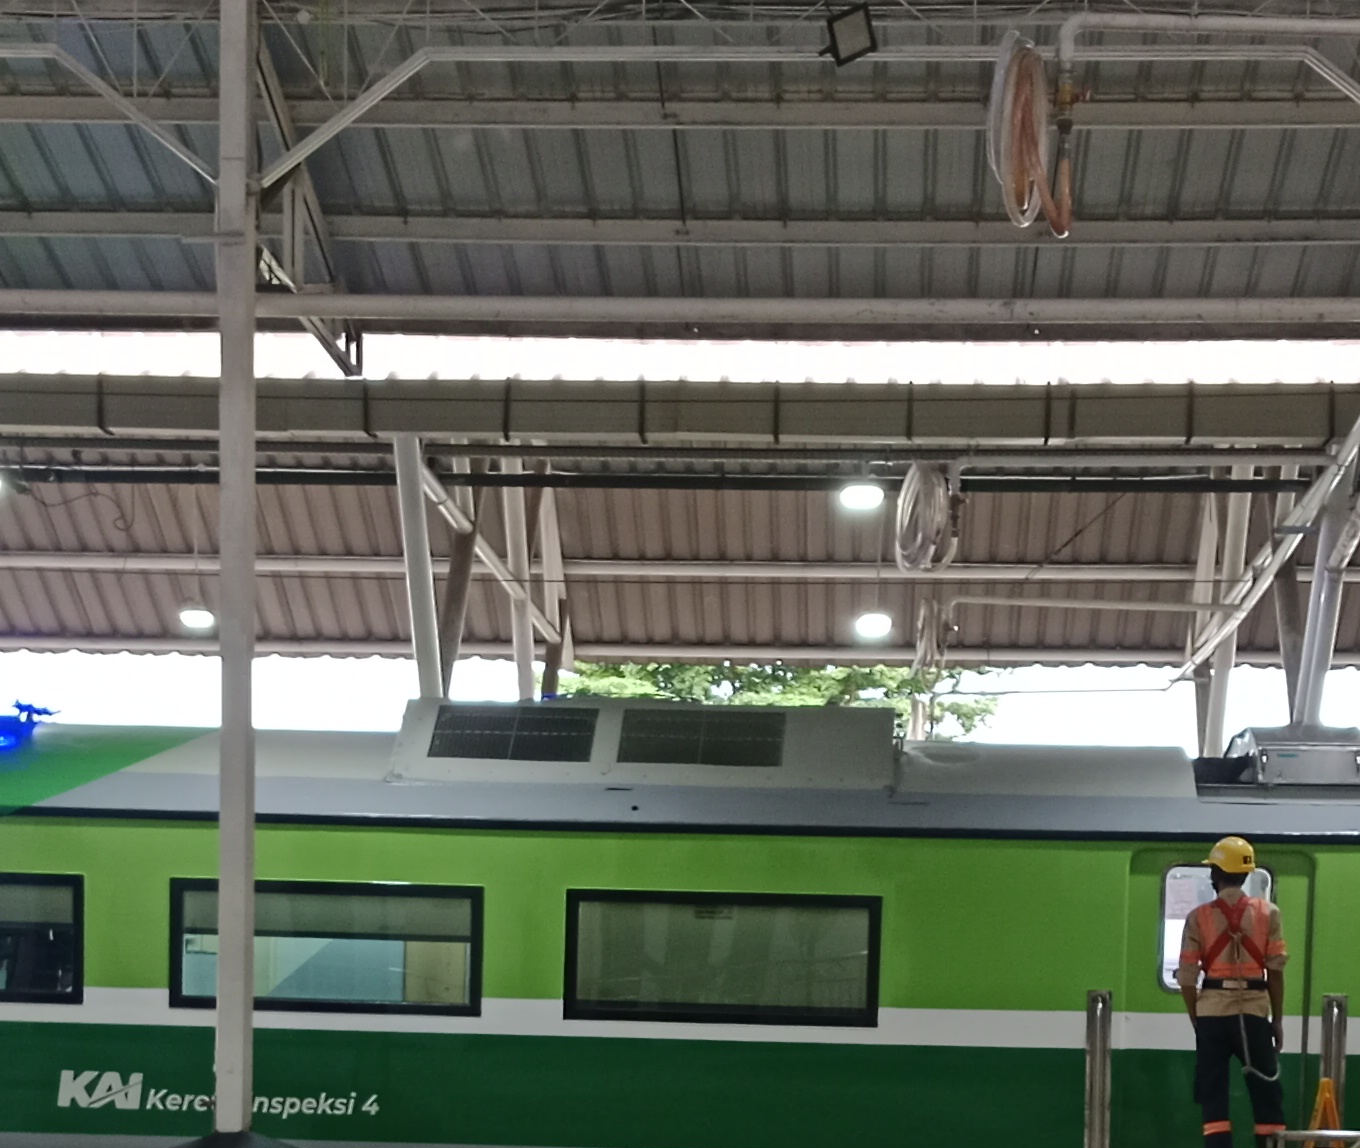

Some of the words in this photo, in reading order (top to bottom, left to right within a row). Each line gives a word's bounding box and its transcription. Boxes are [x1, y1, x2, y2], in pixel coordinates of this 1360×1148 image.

[57, 1069, 144, 1110] KAI
[145, 1088, 217, 1112] Kere
[251, 1091, 357, 1119] nspeksi
[361, 1094, 380, 1116] 4
